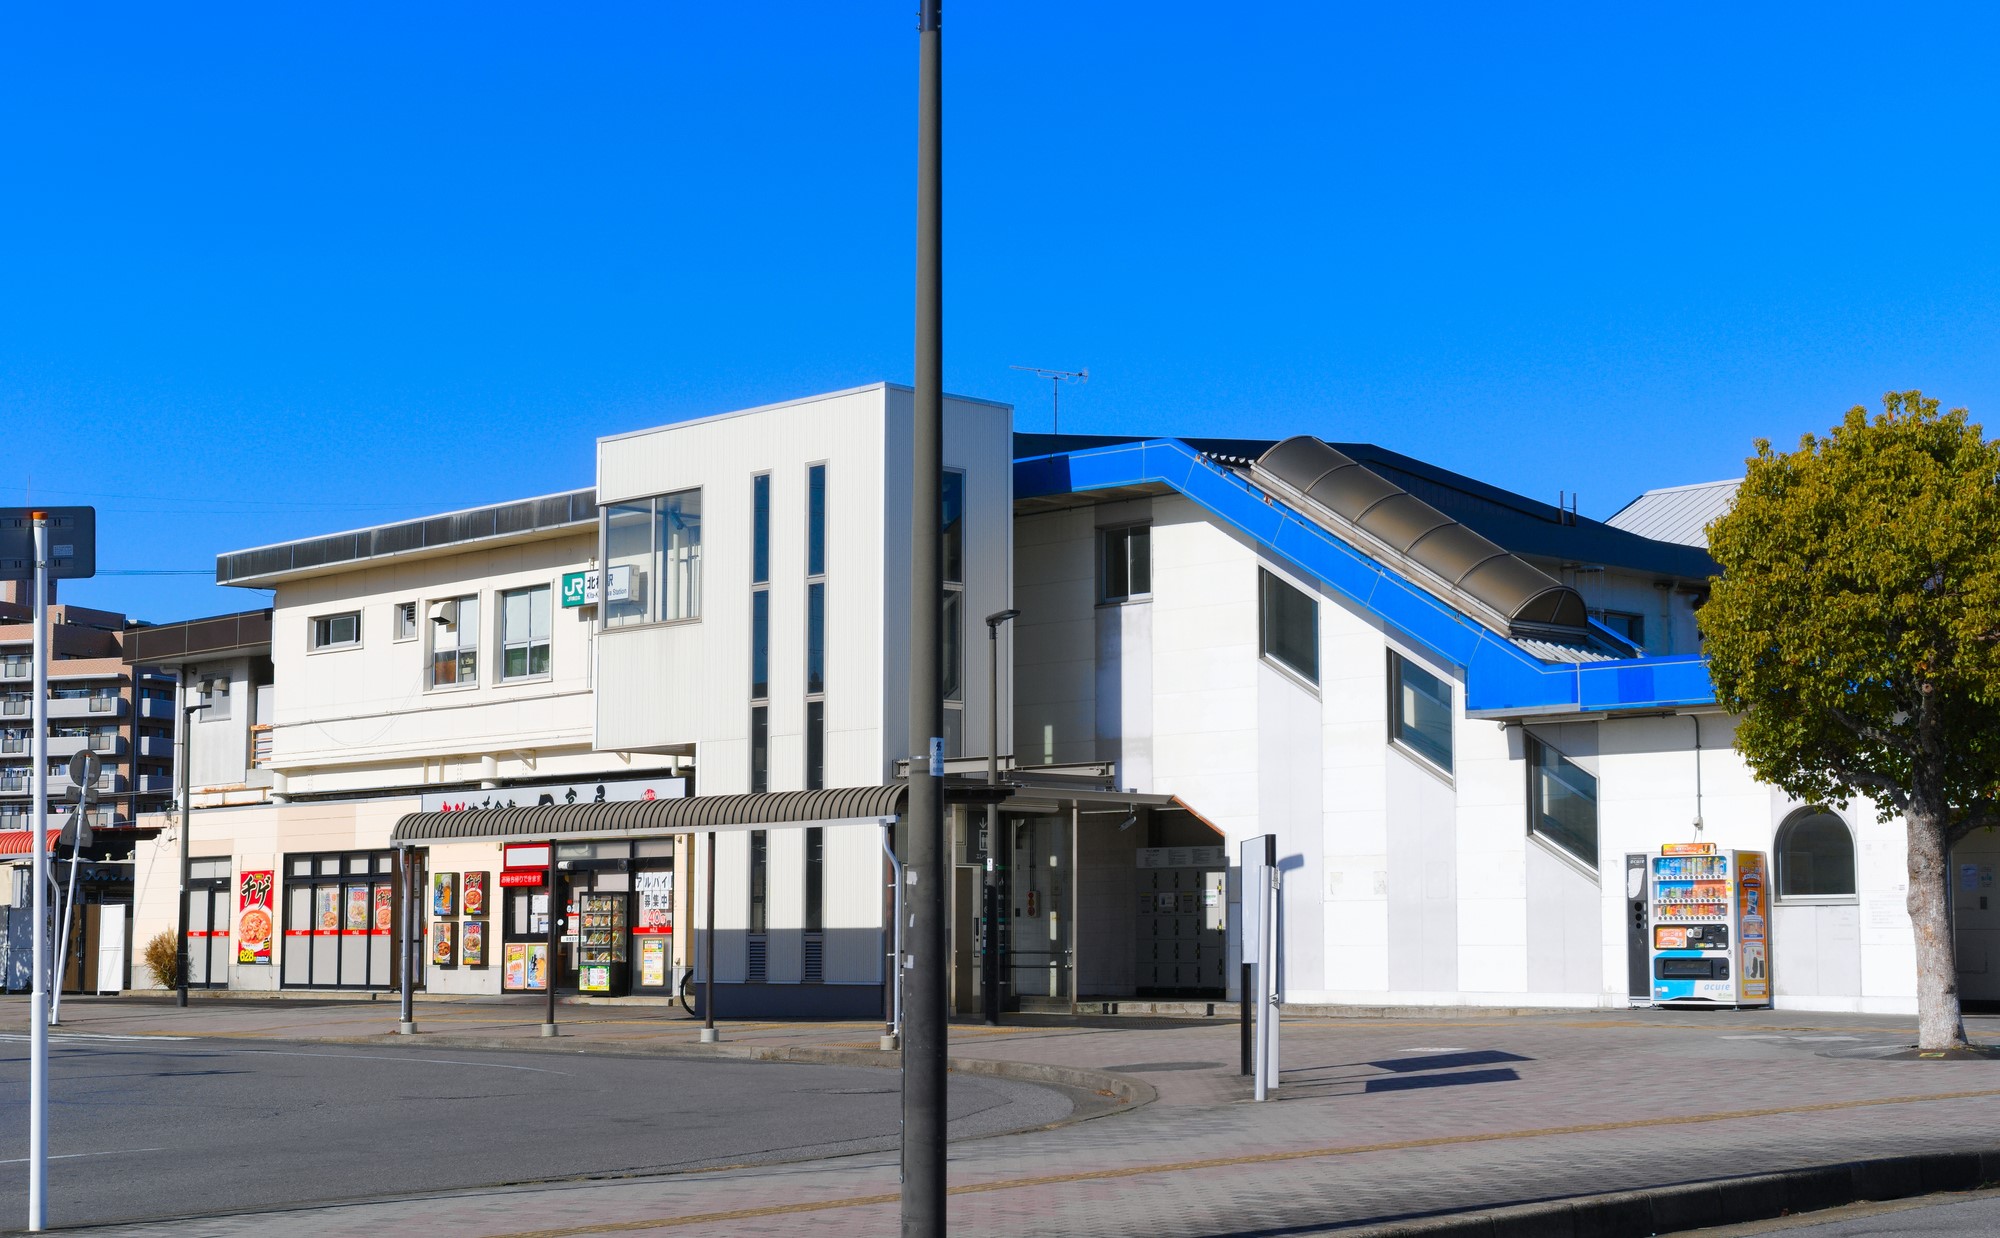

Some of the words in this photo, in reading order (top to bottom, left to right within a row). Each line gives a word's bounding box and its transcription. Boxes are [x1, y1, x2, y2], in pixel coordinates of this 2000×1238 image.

[564, 577, 583, 596] JR
[587, 574, 613, 590] 北駅
[241, 874, 271, 909] チゲ
[644, 894, 668, 908] 募集中
[1703, 983, 1730, 991] acure
